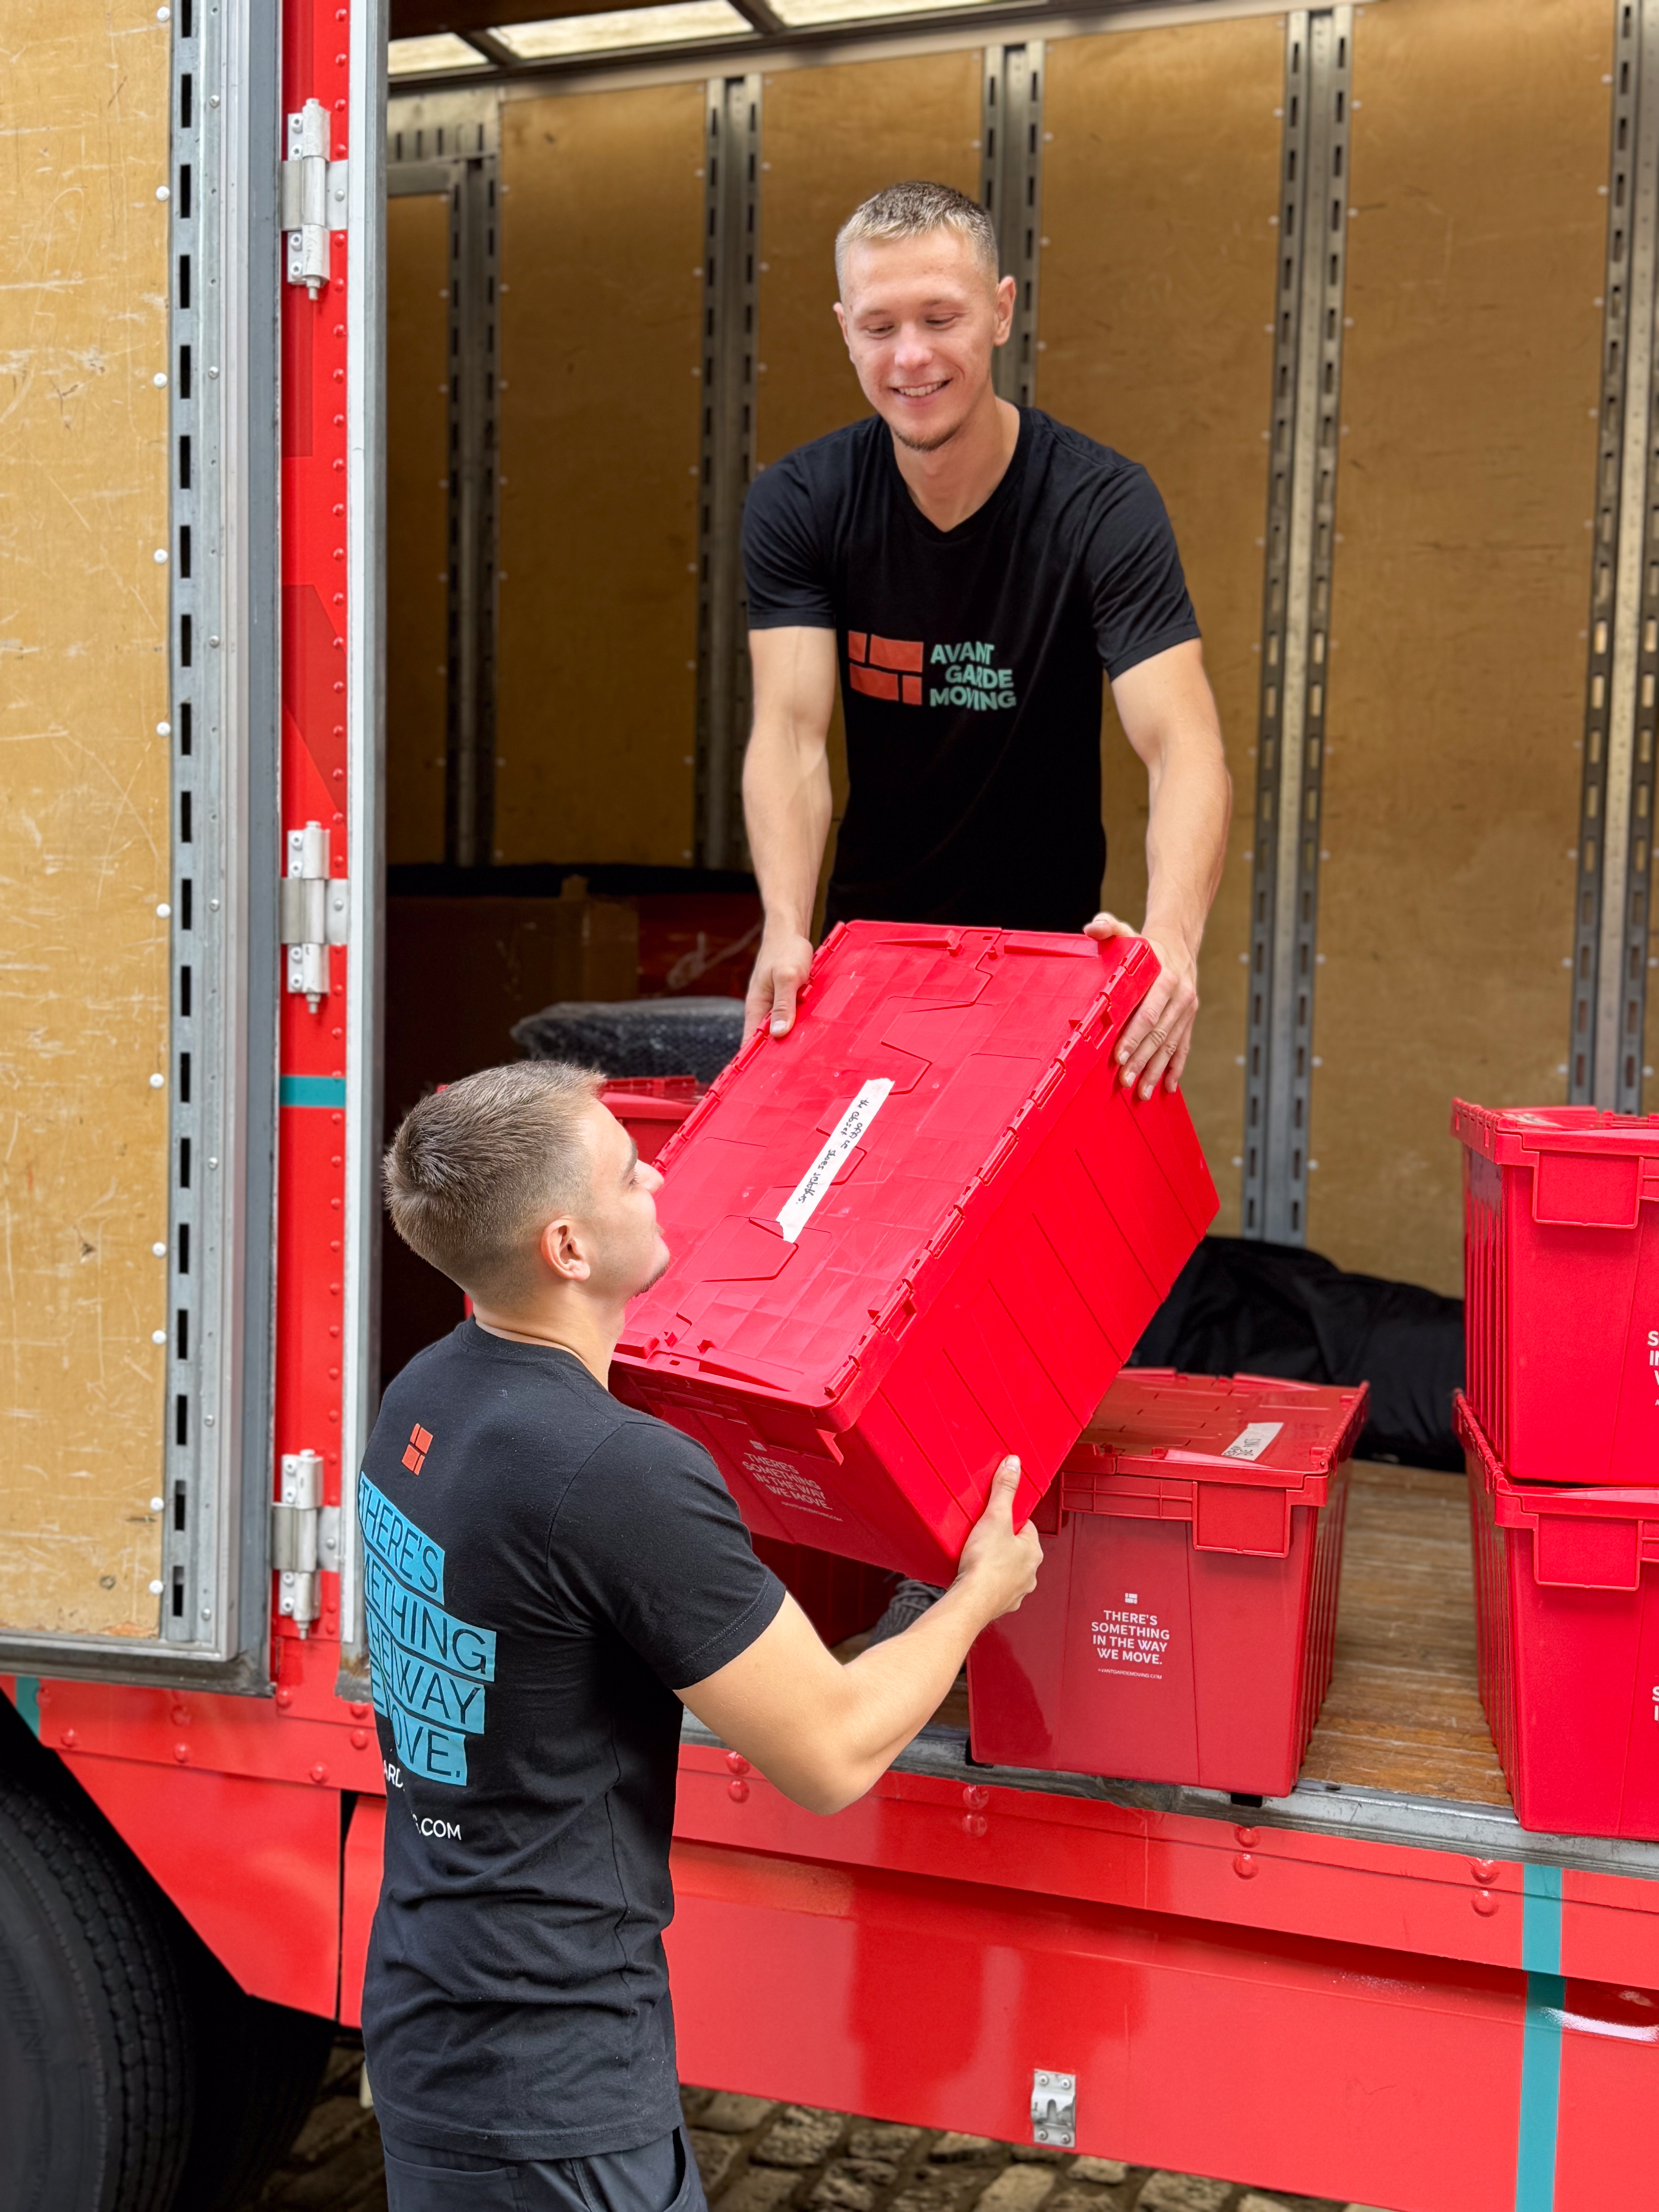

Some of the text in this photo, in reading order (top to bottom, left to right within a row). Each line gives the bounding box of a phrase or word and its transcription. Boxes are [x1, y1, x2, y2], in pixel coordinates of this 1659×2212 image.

[930, 641, 994, 665] AVANT
[945, 664, 1014, 689] GARDE
[930, 685, 1017, 711] MOVING
[742, 1461, 821, 1490] SOMETHING
[765, 1484, 792, 1498] WE
[768, 1476, 798, 1491] THE
[795, 1483, 826, 1500] WAY
[361, 1479, 439, 1593] THERE'S
[1103, 1610, 1158, 1626] THERE'S
[1091, 1621, 1170, 1640] SOMETHING
[1092, 1634, 1168, 1652] IN THE WAY
[1097, 1647, 1163, 1665] WE MOVE.
[393, 1646, 481, 1724] WAY
